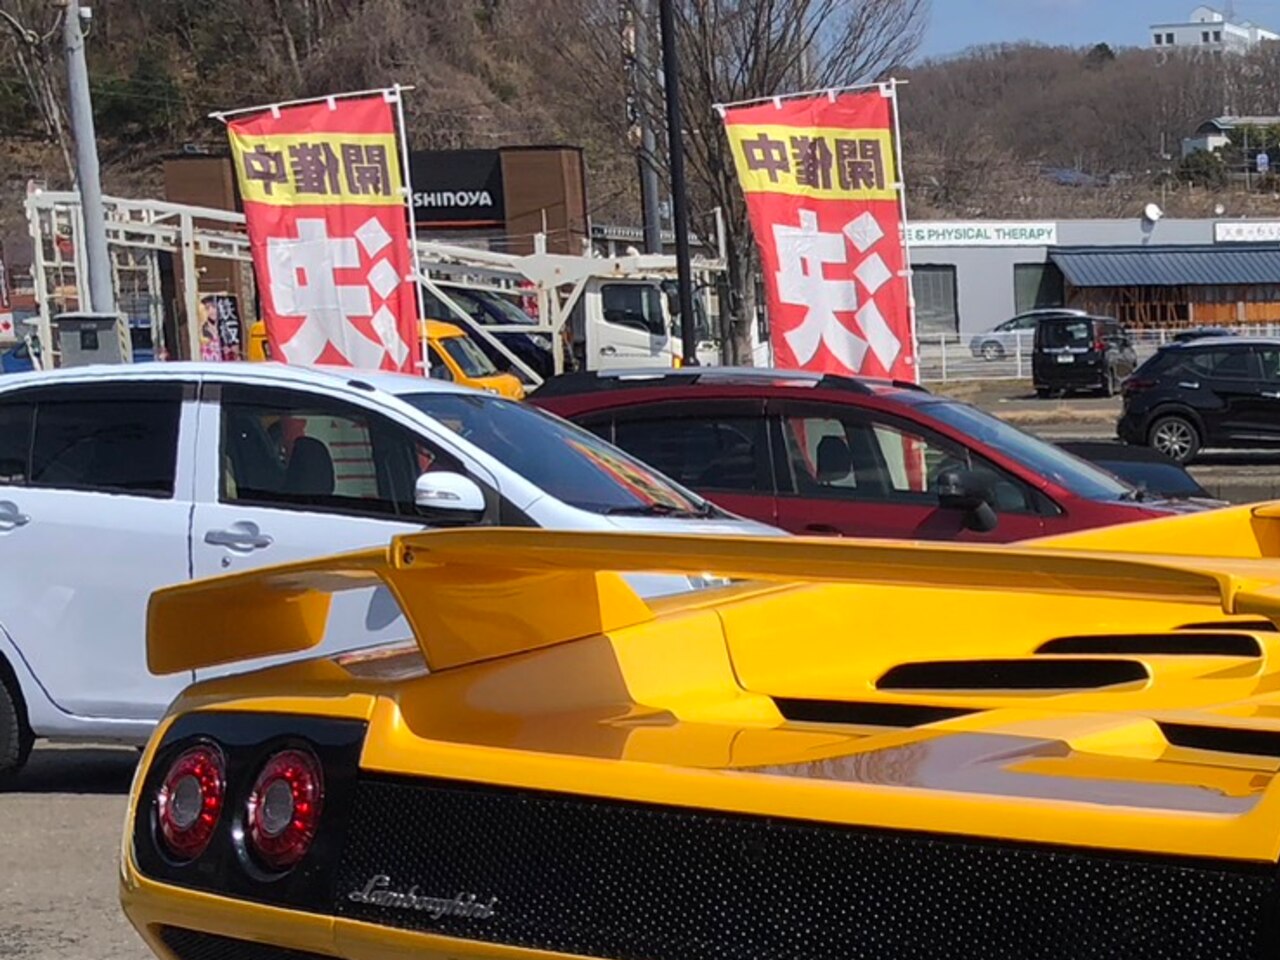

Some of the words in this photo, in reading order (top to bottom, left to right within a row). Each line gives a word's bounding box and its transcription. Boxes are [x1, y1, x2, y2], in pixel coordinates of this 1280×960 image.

[915, 229, 925, 240] &
[927, 228, 991, 240] PHYSICAL
[995, 228, 1053, 240] THERAPY
